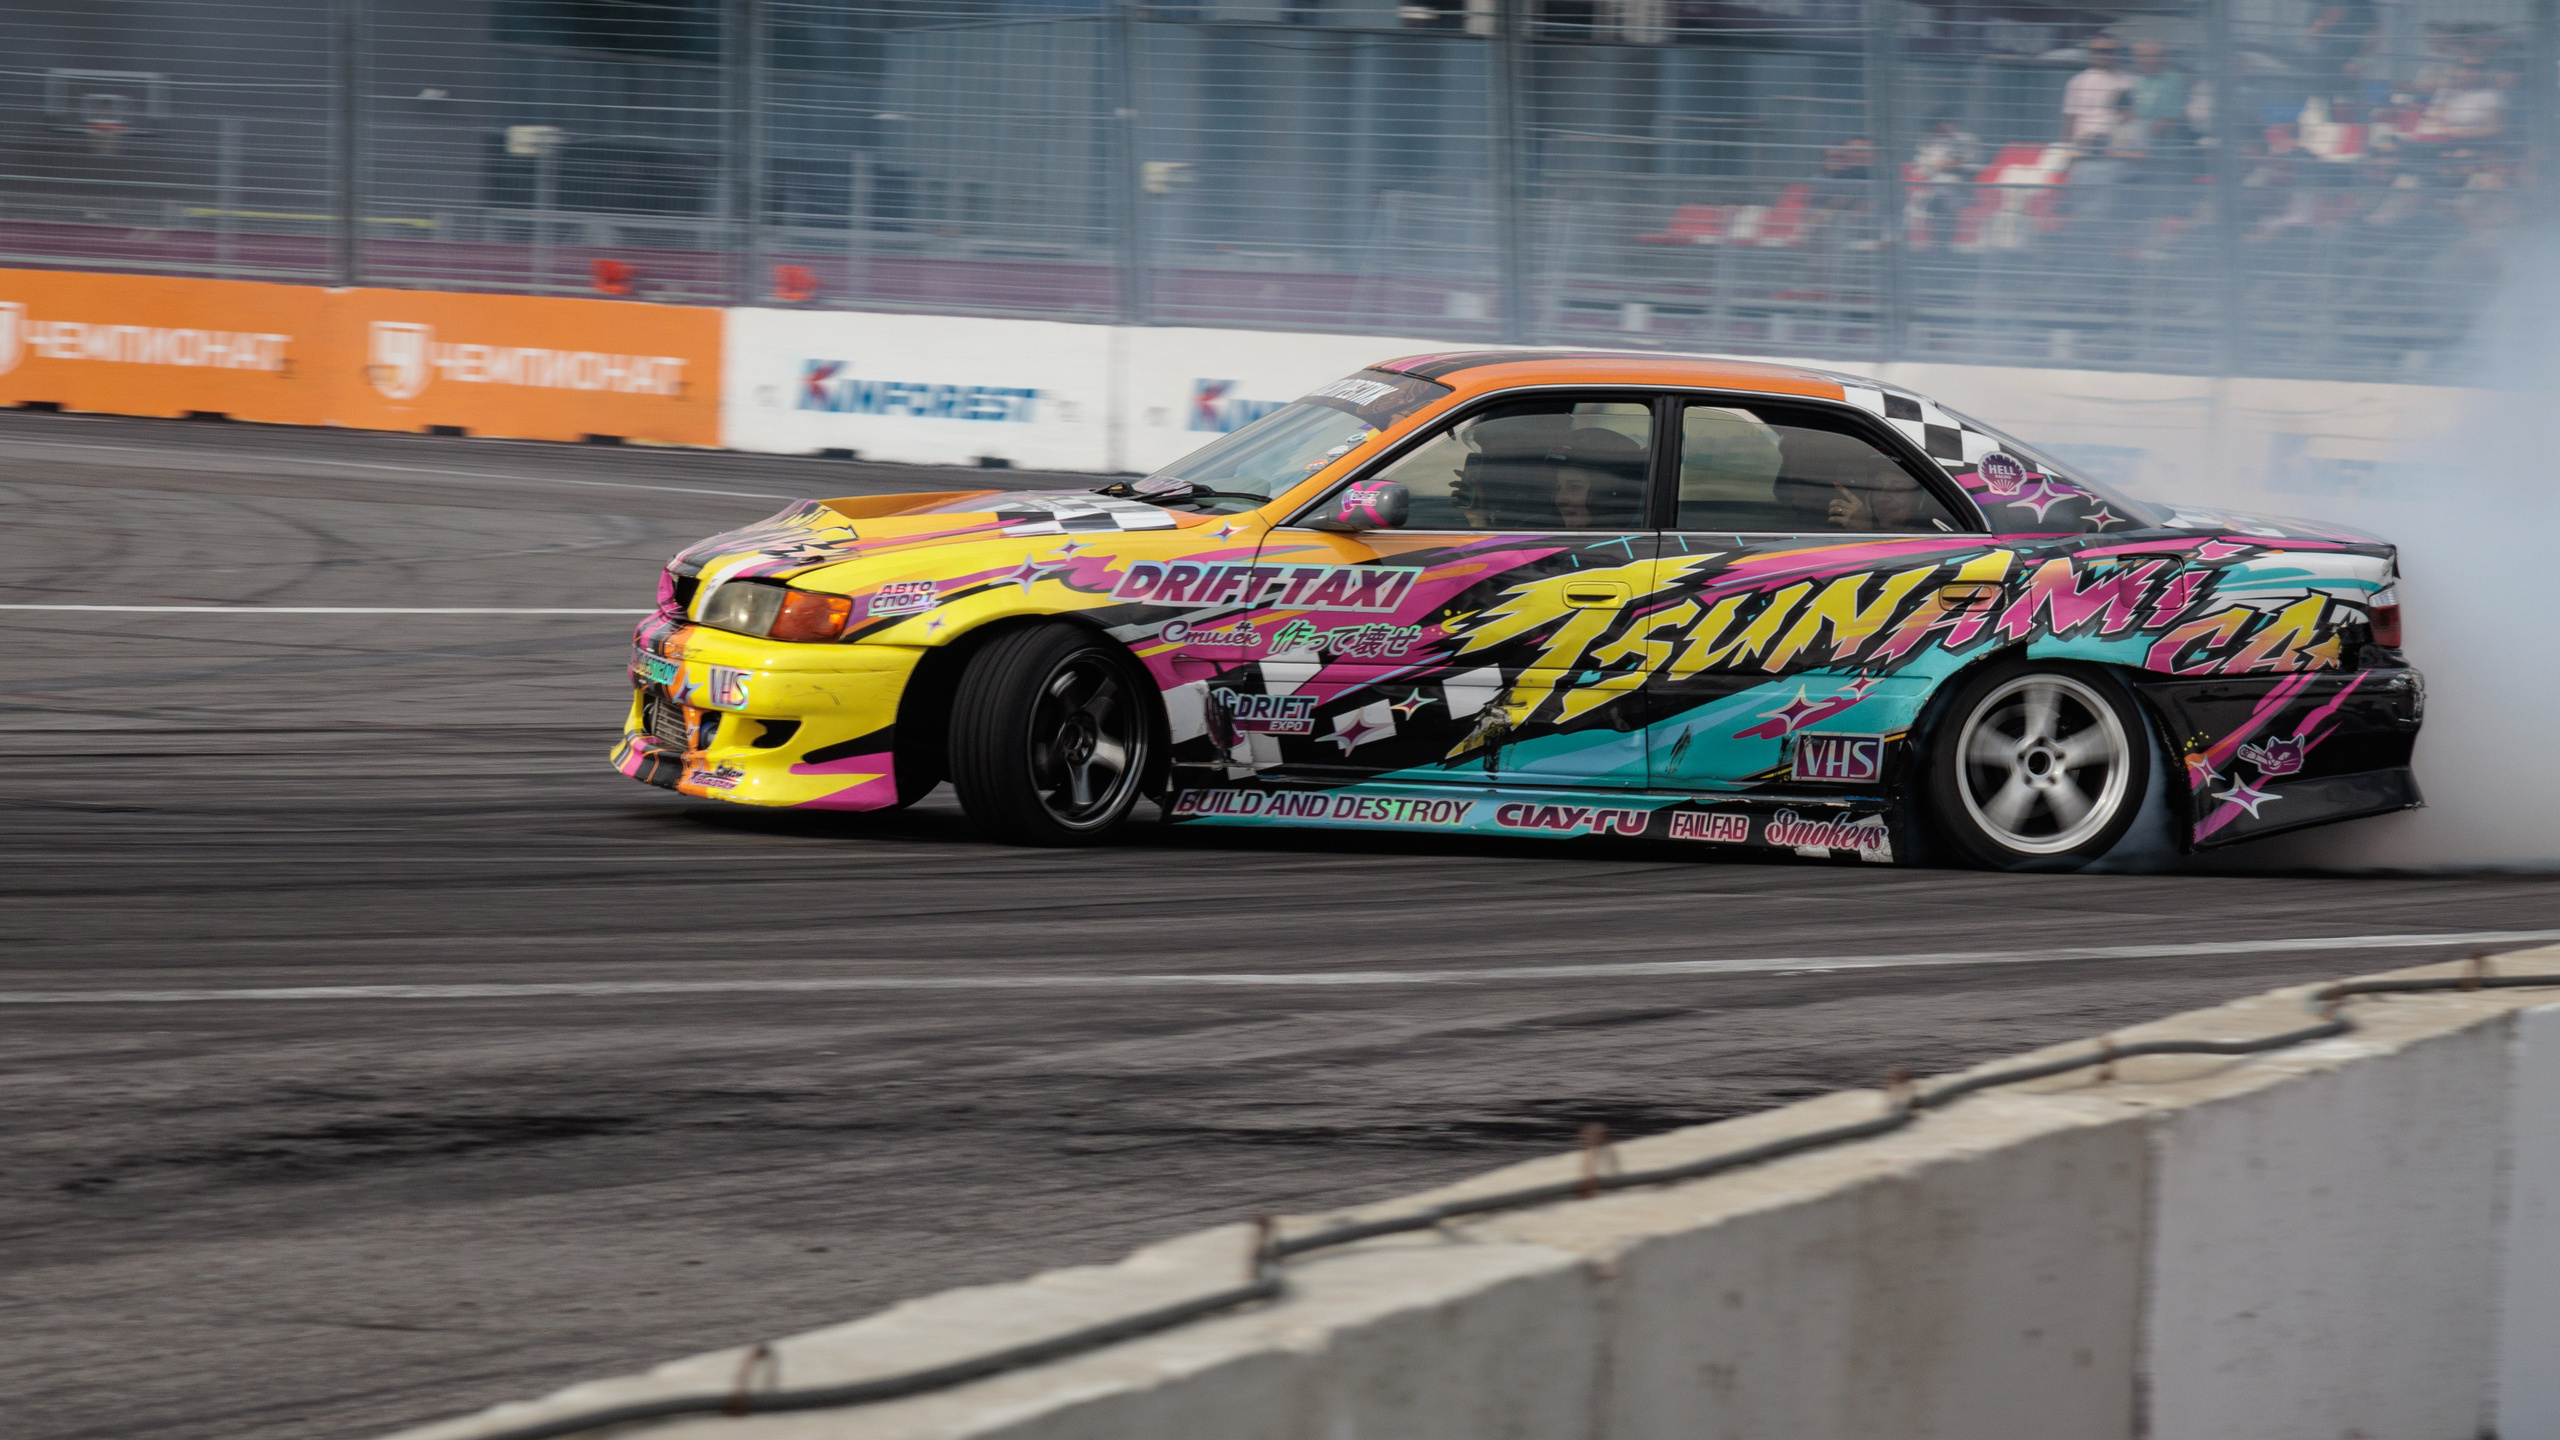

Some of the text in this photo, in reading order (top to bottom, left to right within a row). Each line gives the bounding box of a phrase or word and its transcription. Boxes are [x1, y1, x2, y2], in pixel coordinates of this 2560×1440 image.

[21, 319, 294, 371] ЧЕМПИОНАТ
[428, 342, 690, 395] ЧЕМПИОНАТ
[1988, 464, 2016, 476] HELL
[872, 592, 935, 609] СПОРТ
[880, 580, 934, 596] АВТО
[1113, 564, 1415, 609] DRIFT TAXI
[1270, 620, 1421, 657] 作って壊せ
[710, 667, 751, 707] VHS
[1237, 695, 1317, 719] DRIFT
[1269, 721, 1304, 732] EXPO
[1803, 739, 1877, 778] VHS
[1174, 789, 1474, 824] BUILD AND DESTROY
[1765, 808, 1889, 851] Smokers
